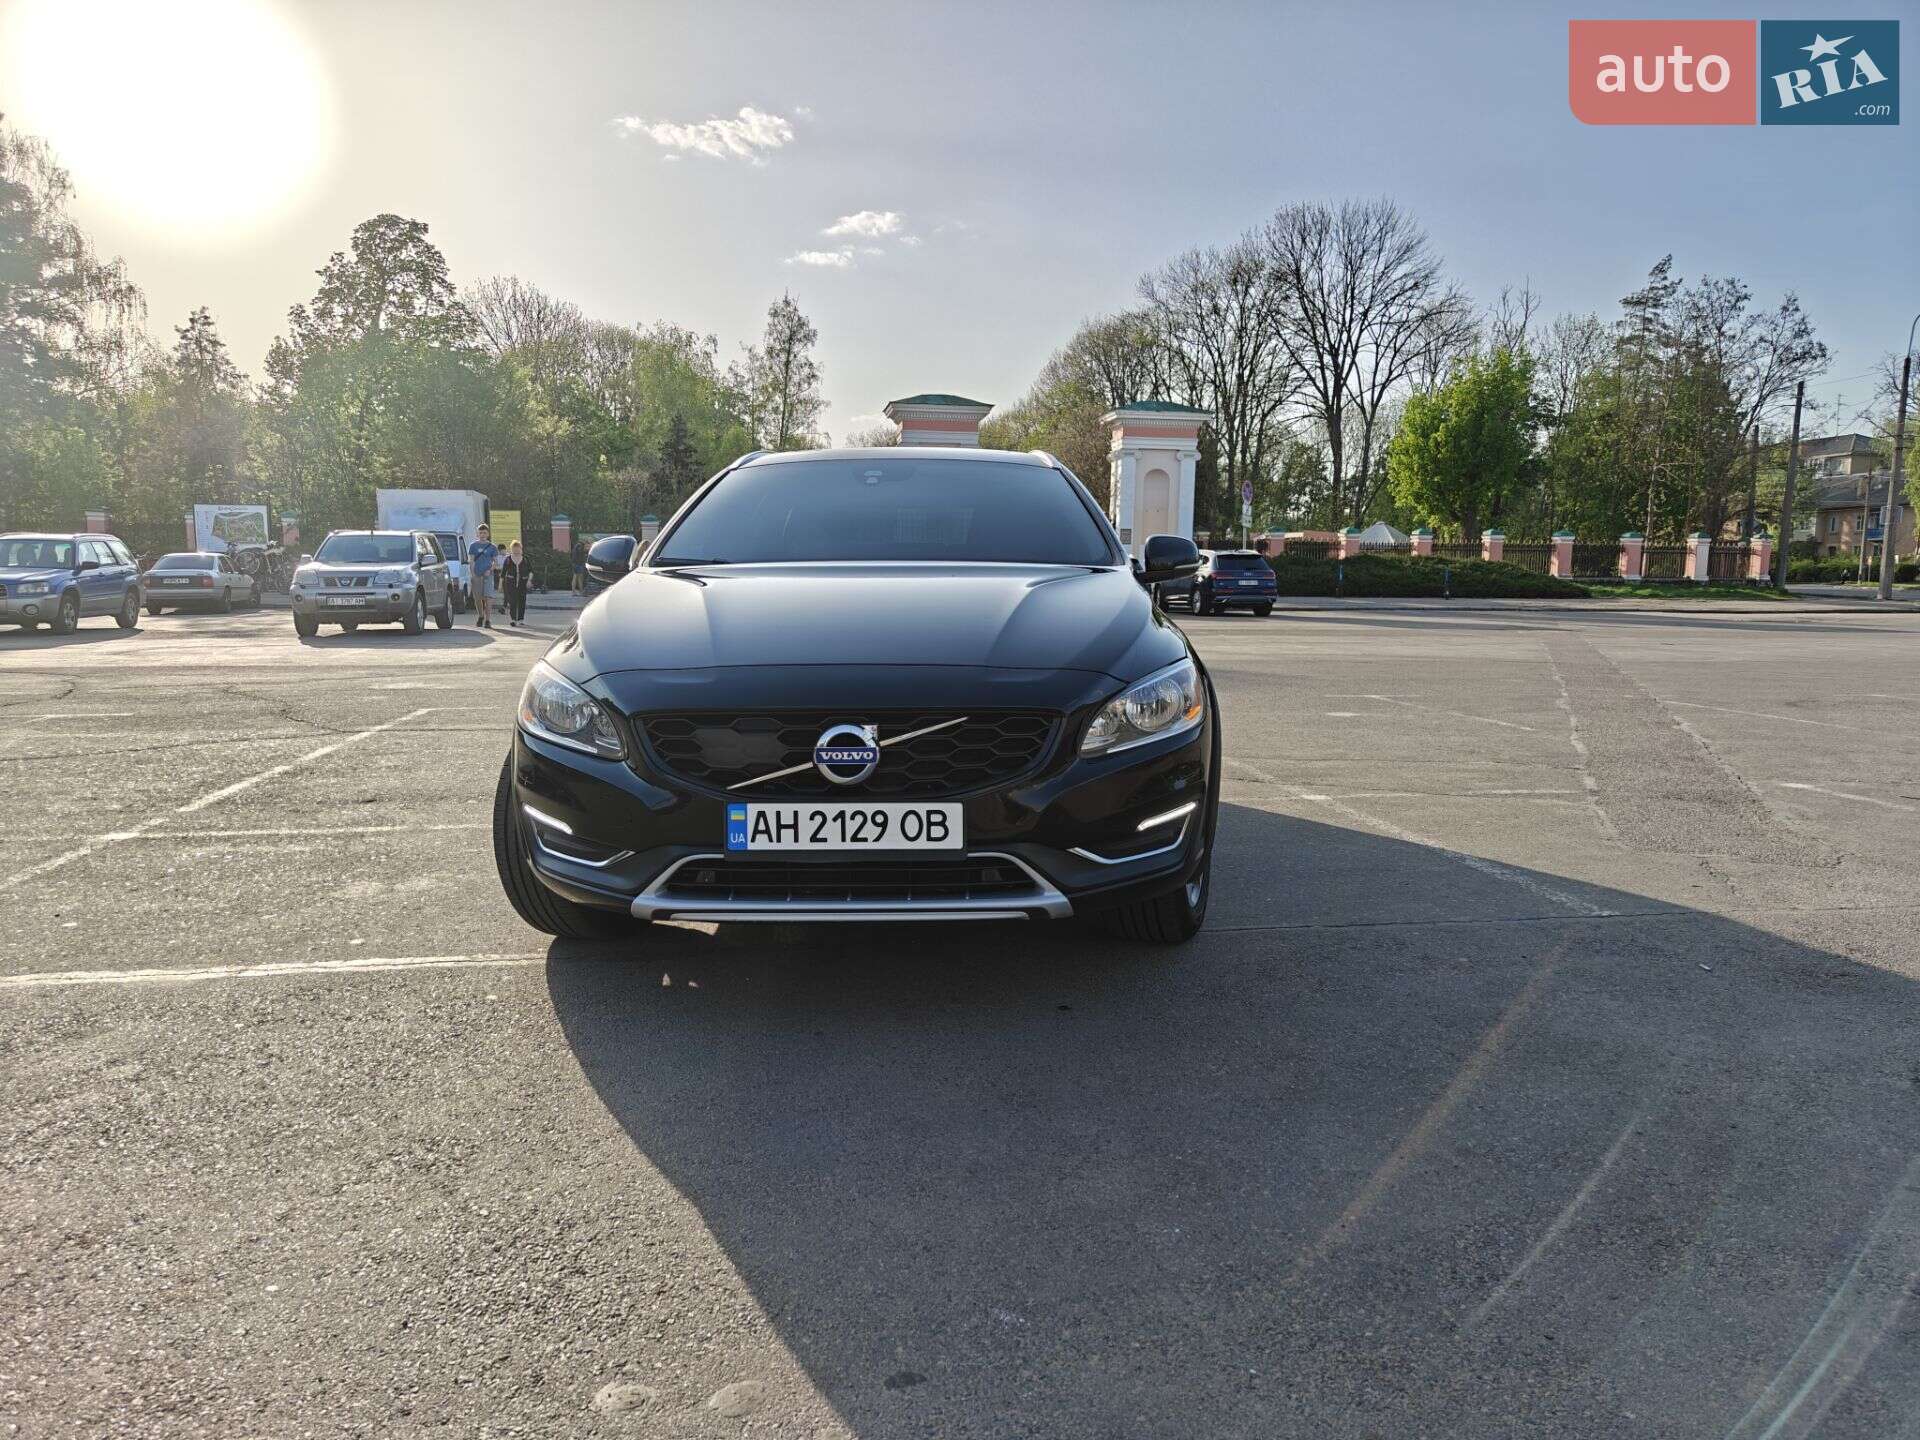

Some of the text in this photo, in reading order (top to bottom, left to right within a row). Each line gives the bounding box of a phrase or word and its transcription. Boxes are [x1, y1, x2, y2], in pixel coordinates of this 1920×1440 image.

[819, 751, 874, 760] VOLVO
[750, 809, 950, 843] AH 2129 OB
[730, 832, 745, 843] UA
